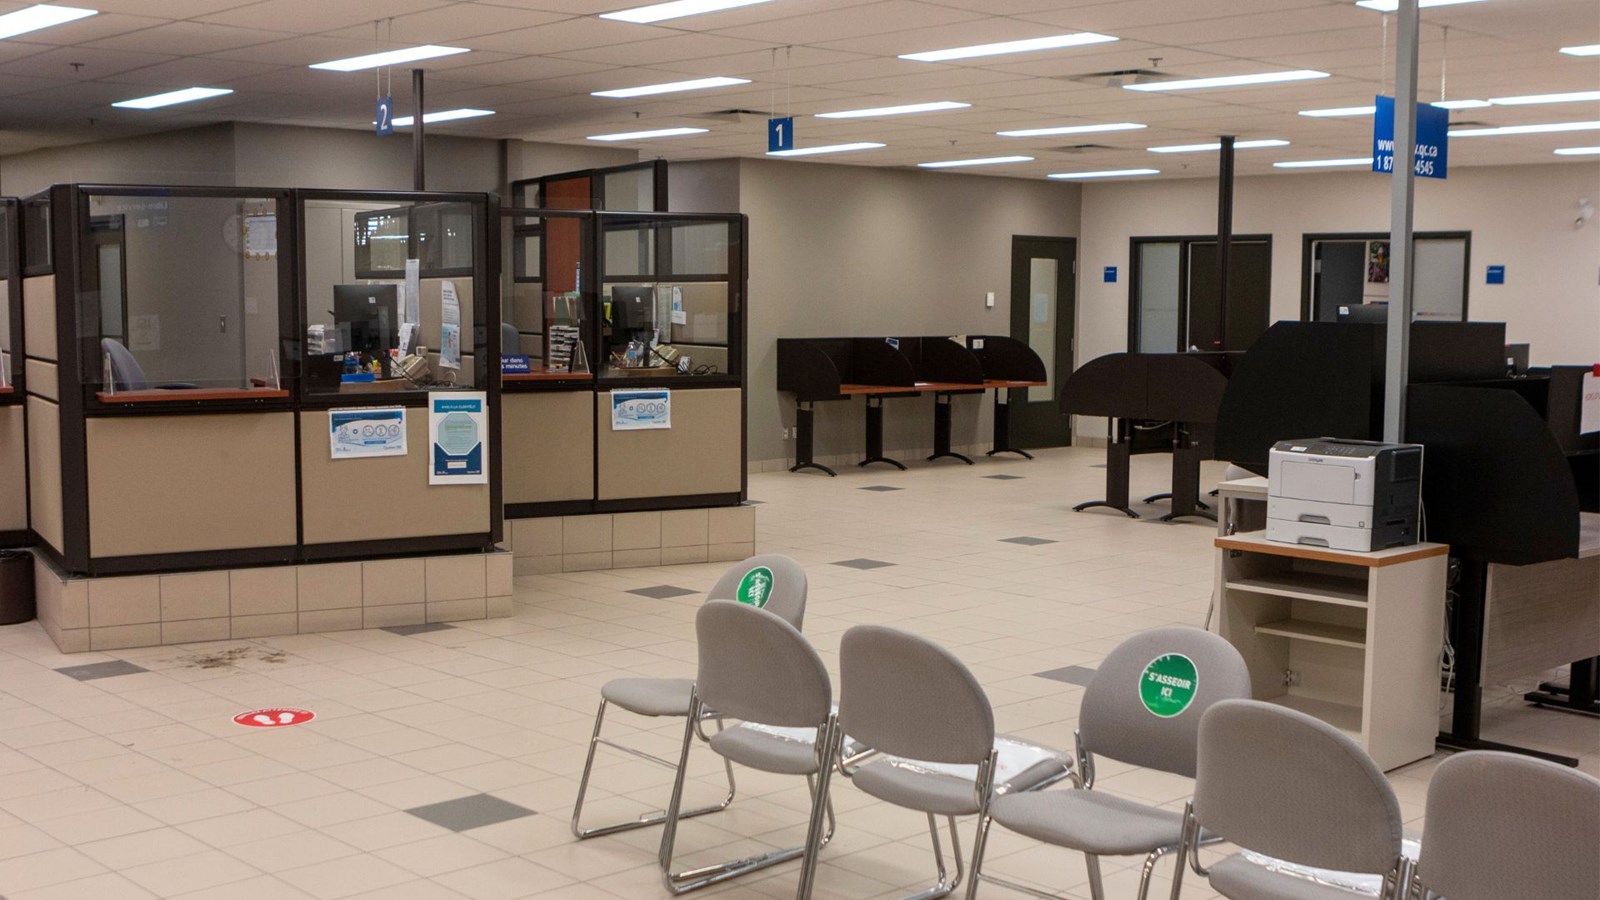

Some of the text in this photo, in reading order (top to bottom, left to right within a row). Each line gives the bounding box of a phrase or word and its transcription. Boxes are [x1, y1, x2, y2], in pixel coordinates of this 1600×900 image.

[380, 104, 388, 130] 2
[775, 124, 783, 147] 1
[1377, 155, 1382, 170] 1
[1383, 155, 1394, 171] 87
[1148, 672, 1191, 690] S'ASSEOIR
[1161, 686, 1173, 697] ICI
